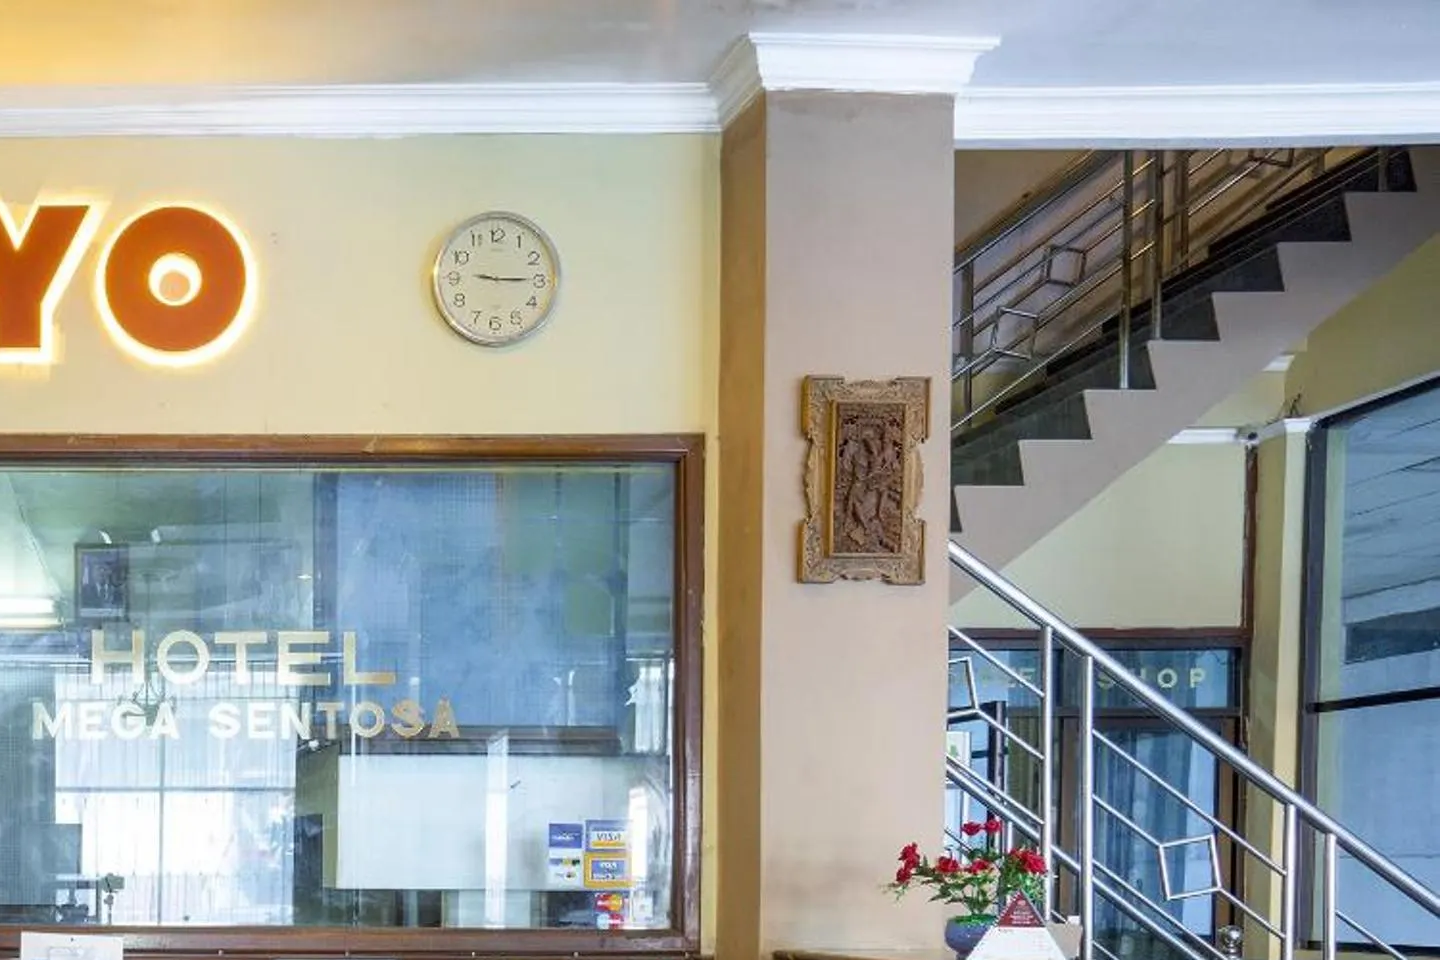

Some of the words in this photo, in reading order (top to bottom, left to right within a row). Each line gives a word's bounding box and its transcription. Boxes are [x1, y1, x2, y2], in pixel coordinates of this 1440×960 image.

[490, 227, 506, 244] 12
[516, 235, 522, 249] 1
[453, 250, 470, 265] 10
[527, 251, 541, 266] 2
[532, 273, 546, 289] 3
[453, 293, 466, 308] 8
[525, 295, 538, 309] 4
[471, 310, 483, 325] 7
[488, 316, 502, 331] 6
[510, 310, 522, 326] 5
[90, 629, 396, 686] HOTEL
[32, 701, 181, 741] MEGA
[208, 699, 460, 741] SENTOSA
